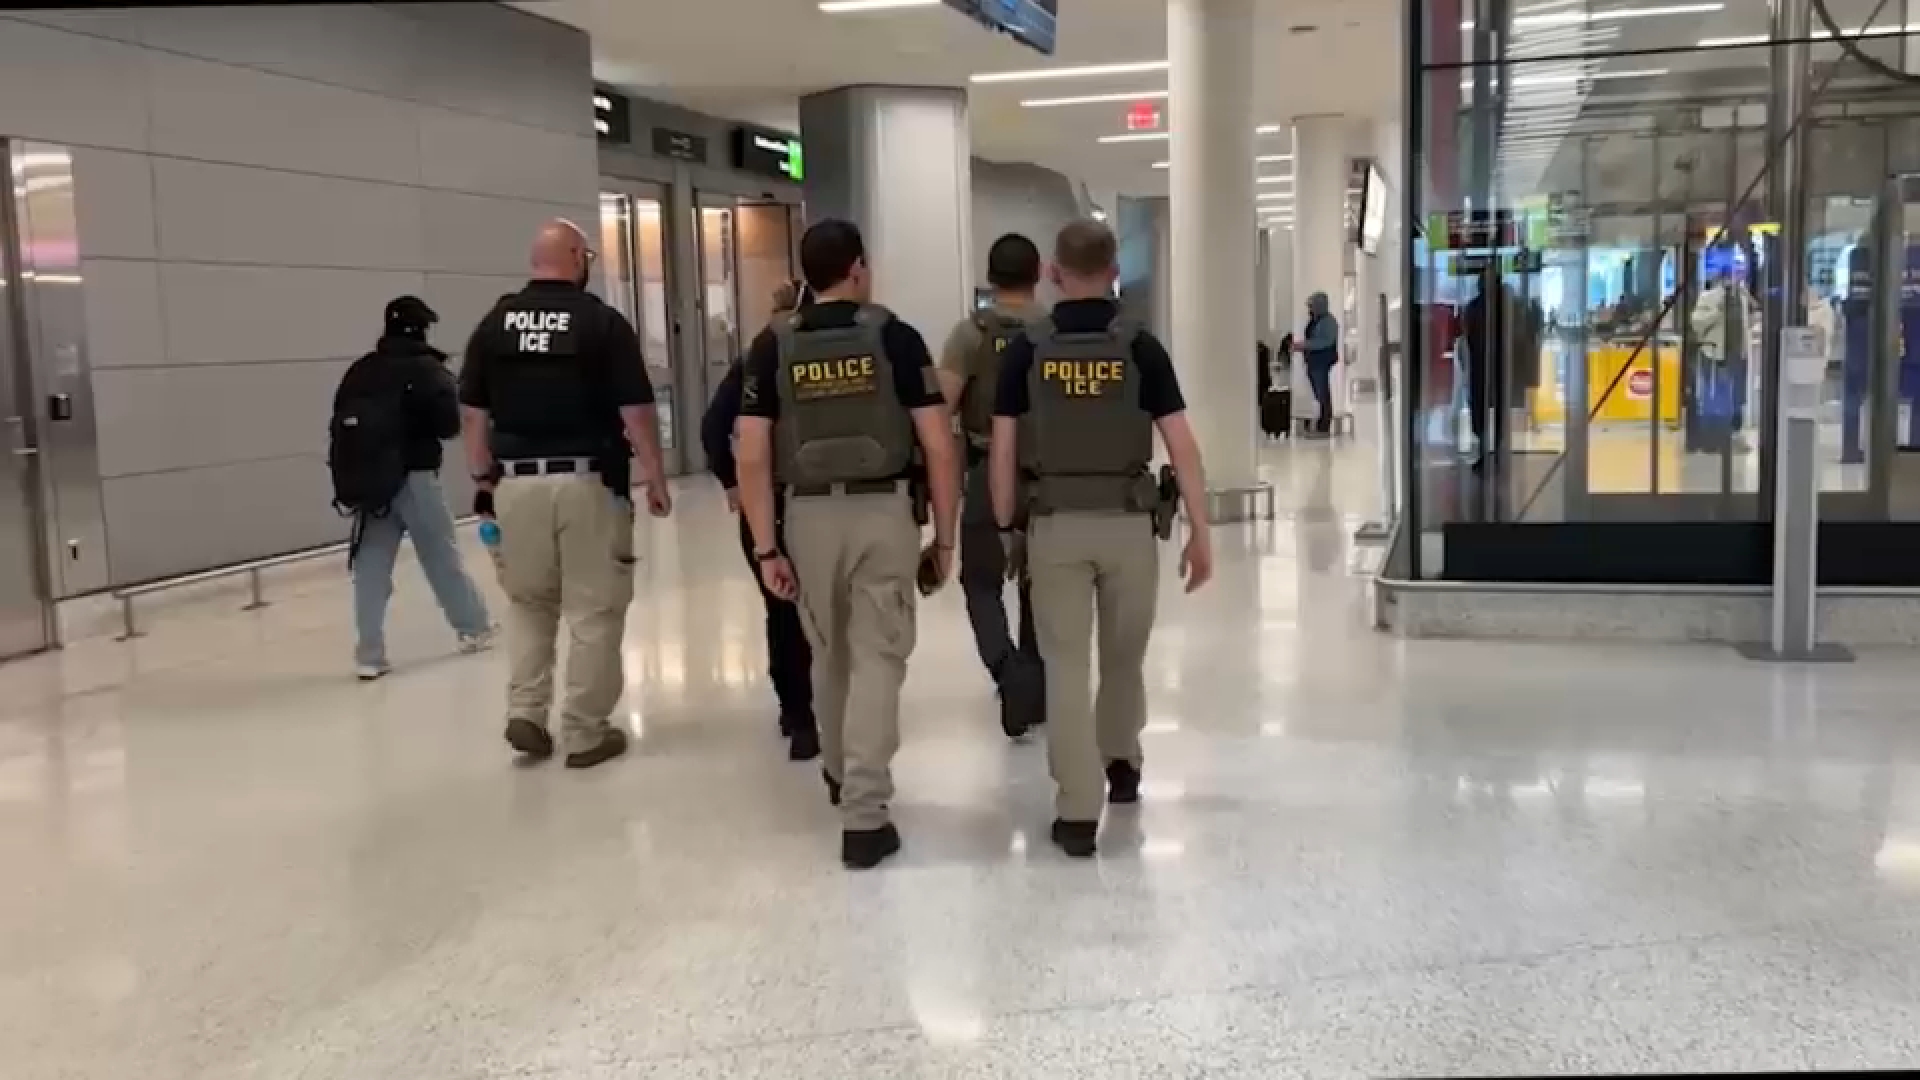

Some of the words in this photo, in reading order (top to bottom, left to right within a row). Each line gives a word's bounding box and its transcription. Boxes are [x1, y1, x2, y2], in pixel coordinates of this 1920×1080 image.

[504, 311, 571, 331] POLICE
[519, 332, 550, 352] ICE
[792, 356, 874, 383] POLICE
[1043, 361, 1123, 380] POLICE
[1065, 381, 1102, 395] ICE
